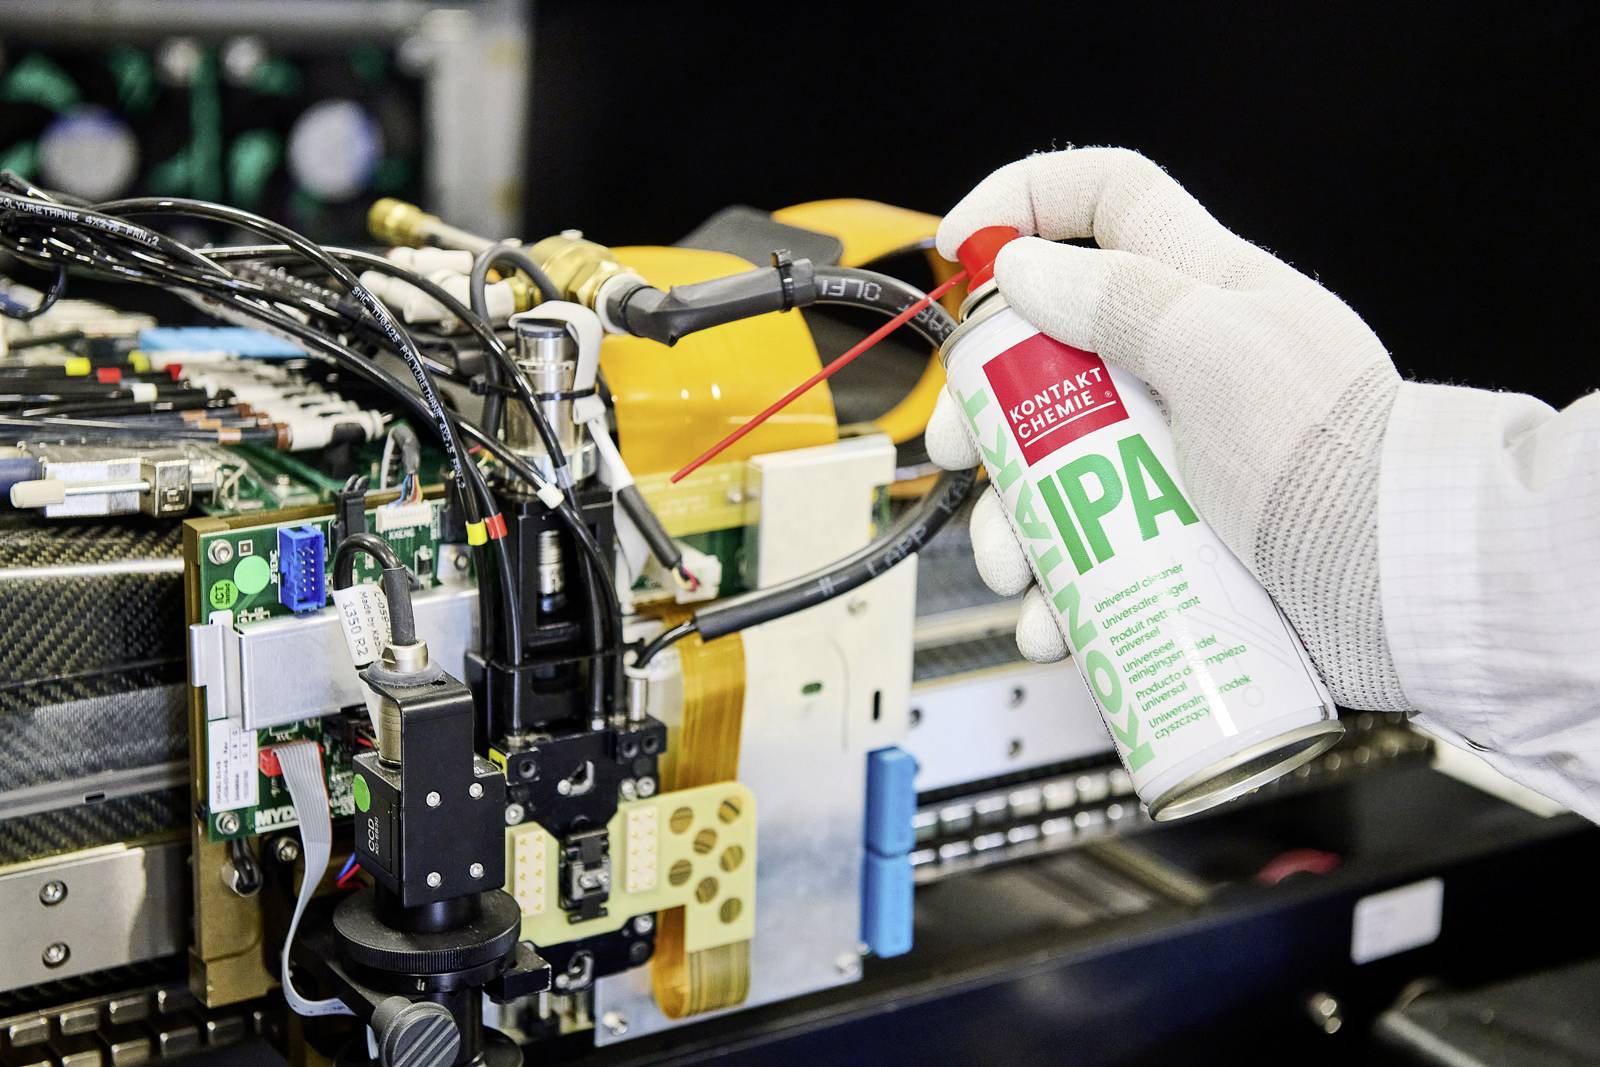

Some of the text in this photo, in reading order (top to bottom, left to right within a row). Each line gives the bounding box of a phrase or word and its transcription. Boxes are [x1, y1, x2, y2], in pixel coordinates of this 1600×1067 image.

[351, 286, 371, 306] SMC
[1009, 367, 1103, 424] KONTAKT
[1018, 390, 1095, 439] CHEMIE
[1037, 433, 1200, 576] IPA
[214, 585, 224, 604] ICT
[957, 387, 1155, 774] KONTAKT
[1094, 581, 1141, 613] Universal
[1102, 581, 1189, 630] Universalreger
[1110, 596, 1200, 646] Produit nettyant
[342, 601, 369, 656] 1350 R2
[1116, 626, 1161, 657] universel
[1123, 639, 1175, 673] Universeel
[1136, 671, 1182, 700] Producto
[1141, 682, 1188, 712] universal
[1149, 674, 1252, 728] Uniwersaln rodek
[255, 804, 299, 827] MYD
[367, 818, 375, 852] CCD
